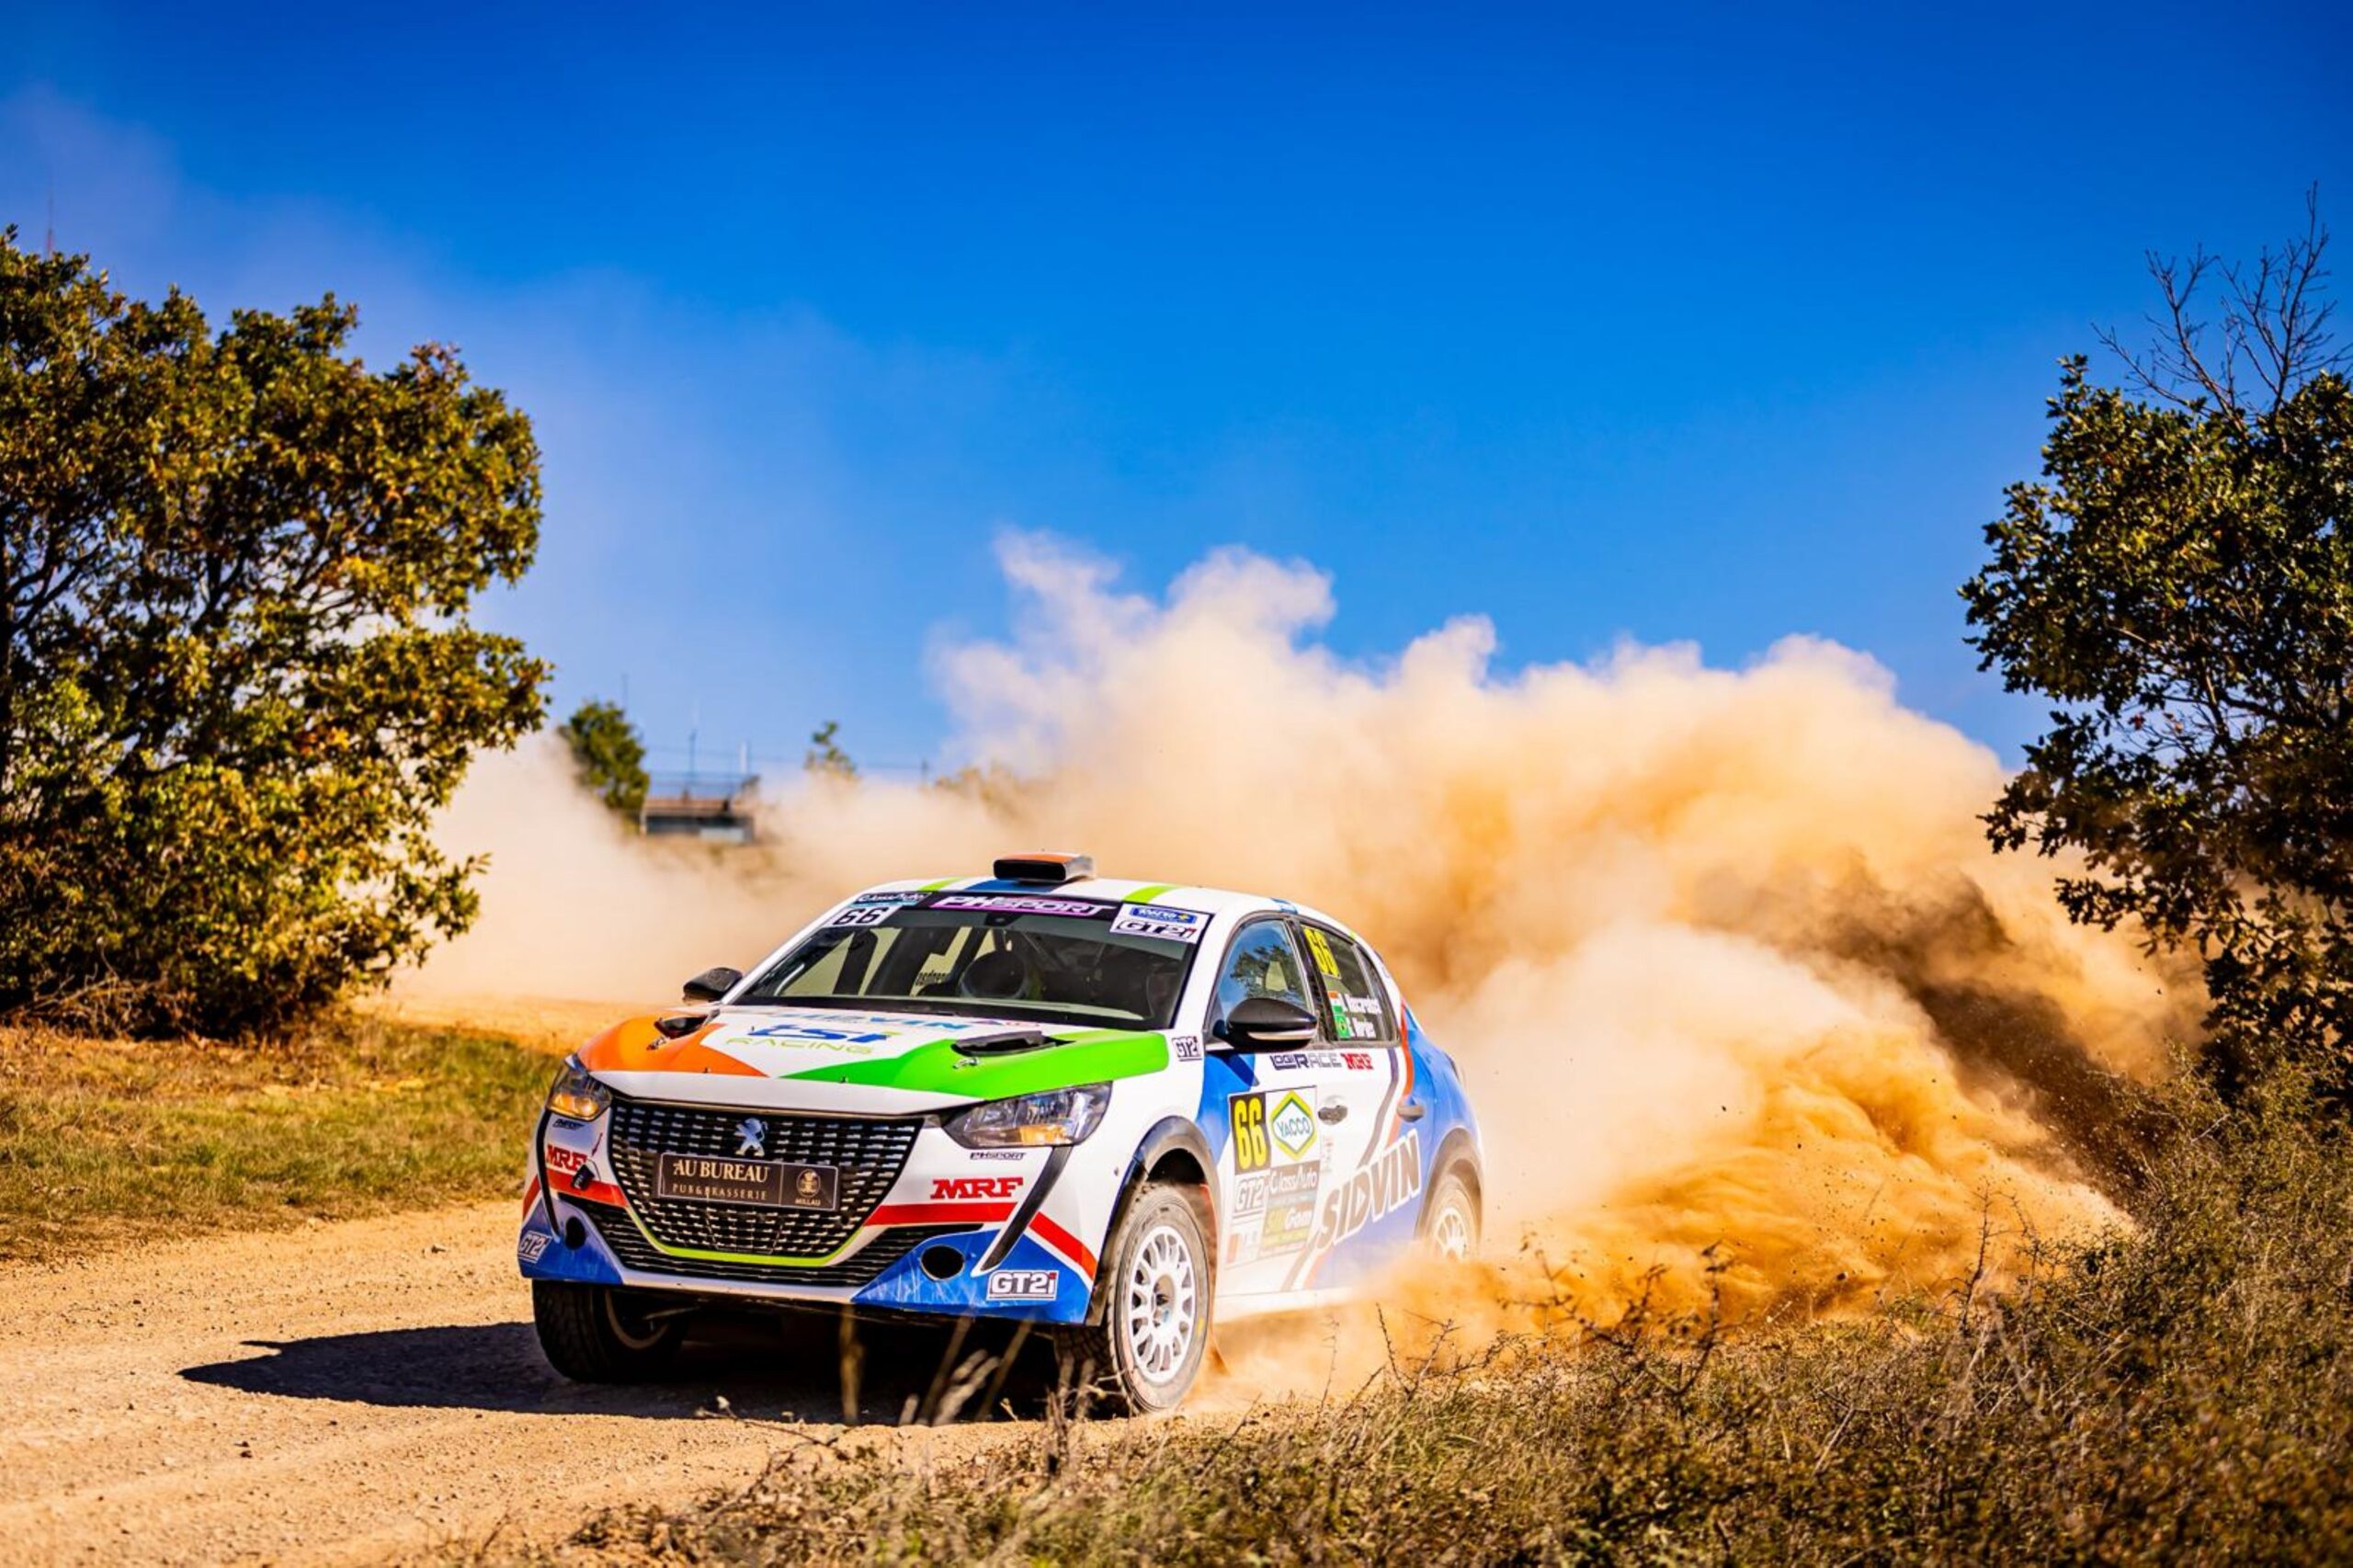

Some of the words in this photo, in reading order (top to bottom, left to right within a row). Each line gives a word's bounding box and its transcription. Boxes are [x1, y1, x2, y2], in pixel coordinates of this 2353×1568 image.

[832, 906, 890, 926] 66
[1302, 927, 1340, 978] 66
[724, 1036, 872, 1055] RACING
[1234, 1097, 1267, 1170] 66
[1277, 1117, 1311, 1138] YACCO
[546, 1143, 588, 1173] MRF
[673, 1159, 698, 1177] AU
[699, 1161, 770, 1183] BUREAU
[930, 1177, 1024, 1199] MRF
[1315, 1128, 1422, 1250] SIDVIN
[795, 1198, 821, 1207] MILLAU
[990, 1271, 1057, 1295] GT2i
